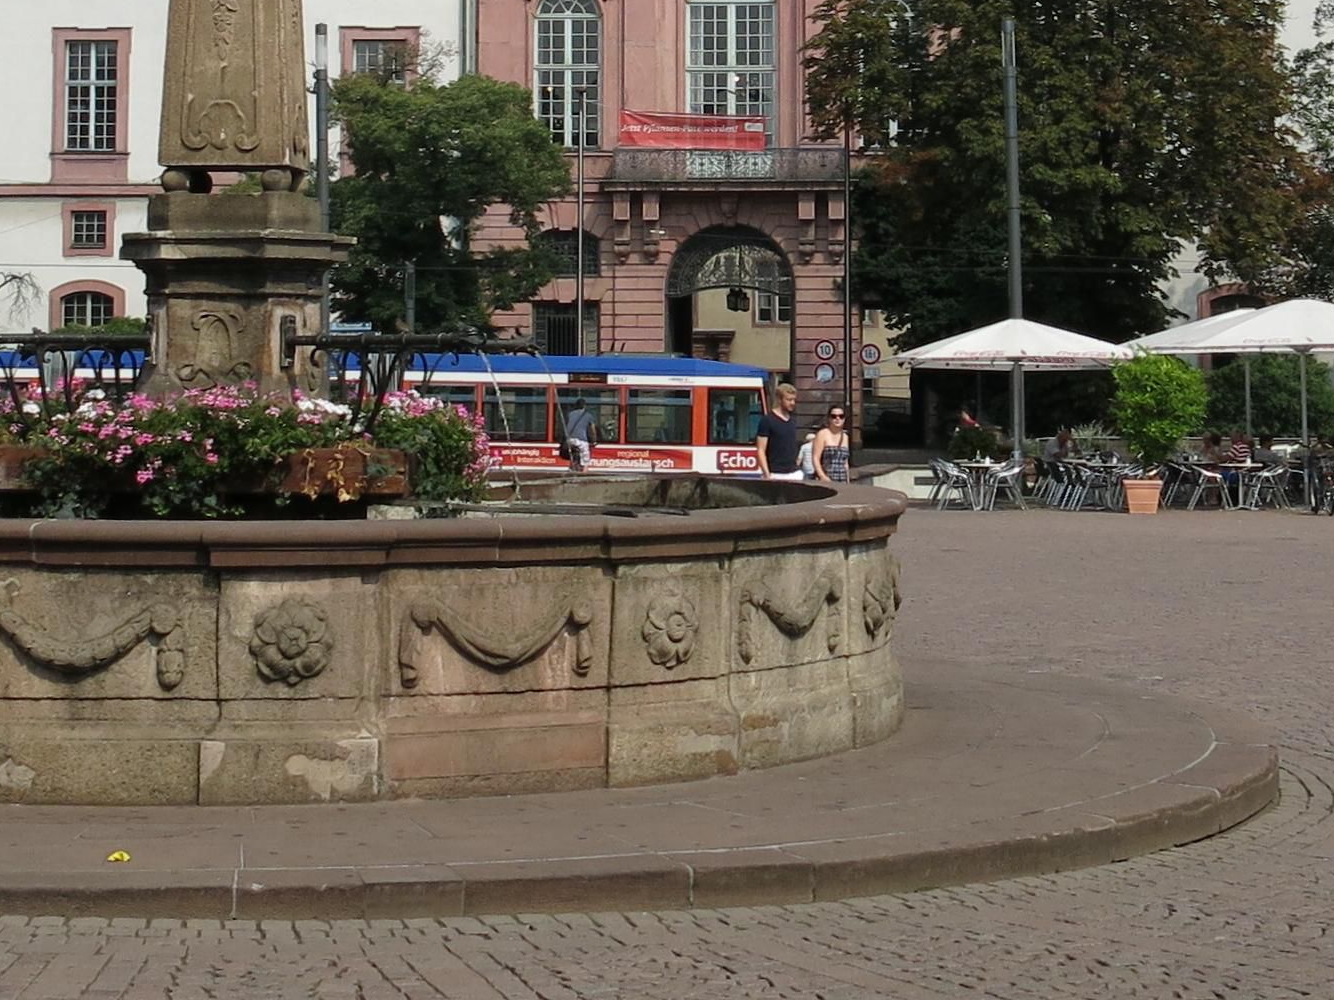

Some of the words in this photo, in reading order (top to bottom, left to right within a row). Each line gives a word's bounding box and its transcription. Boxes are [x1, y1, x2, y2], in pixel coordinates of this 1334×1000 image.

[820, 344, 832, 356] 10
[617, 450, 650, 458] regional
[720, 452, 757, 468] Echo
